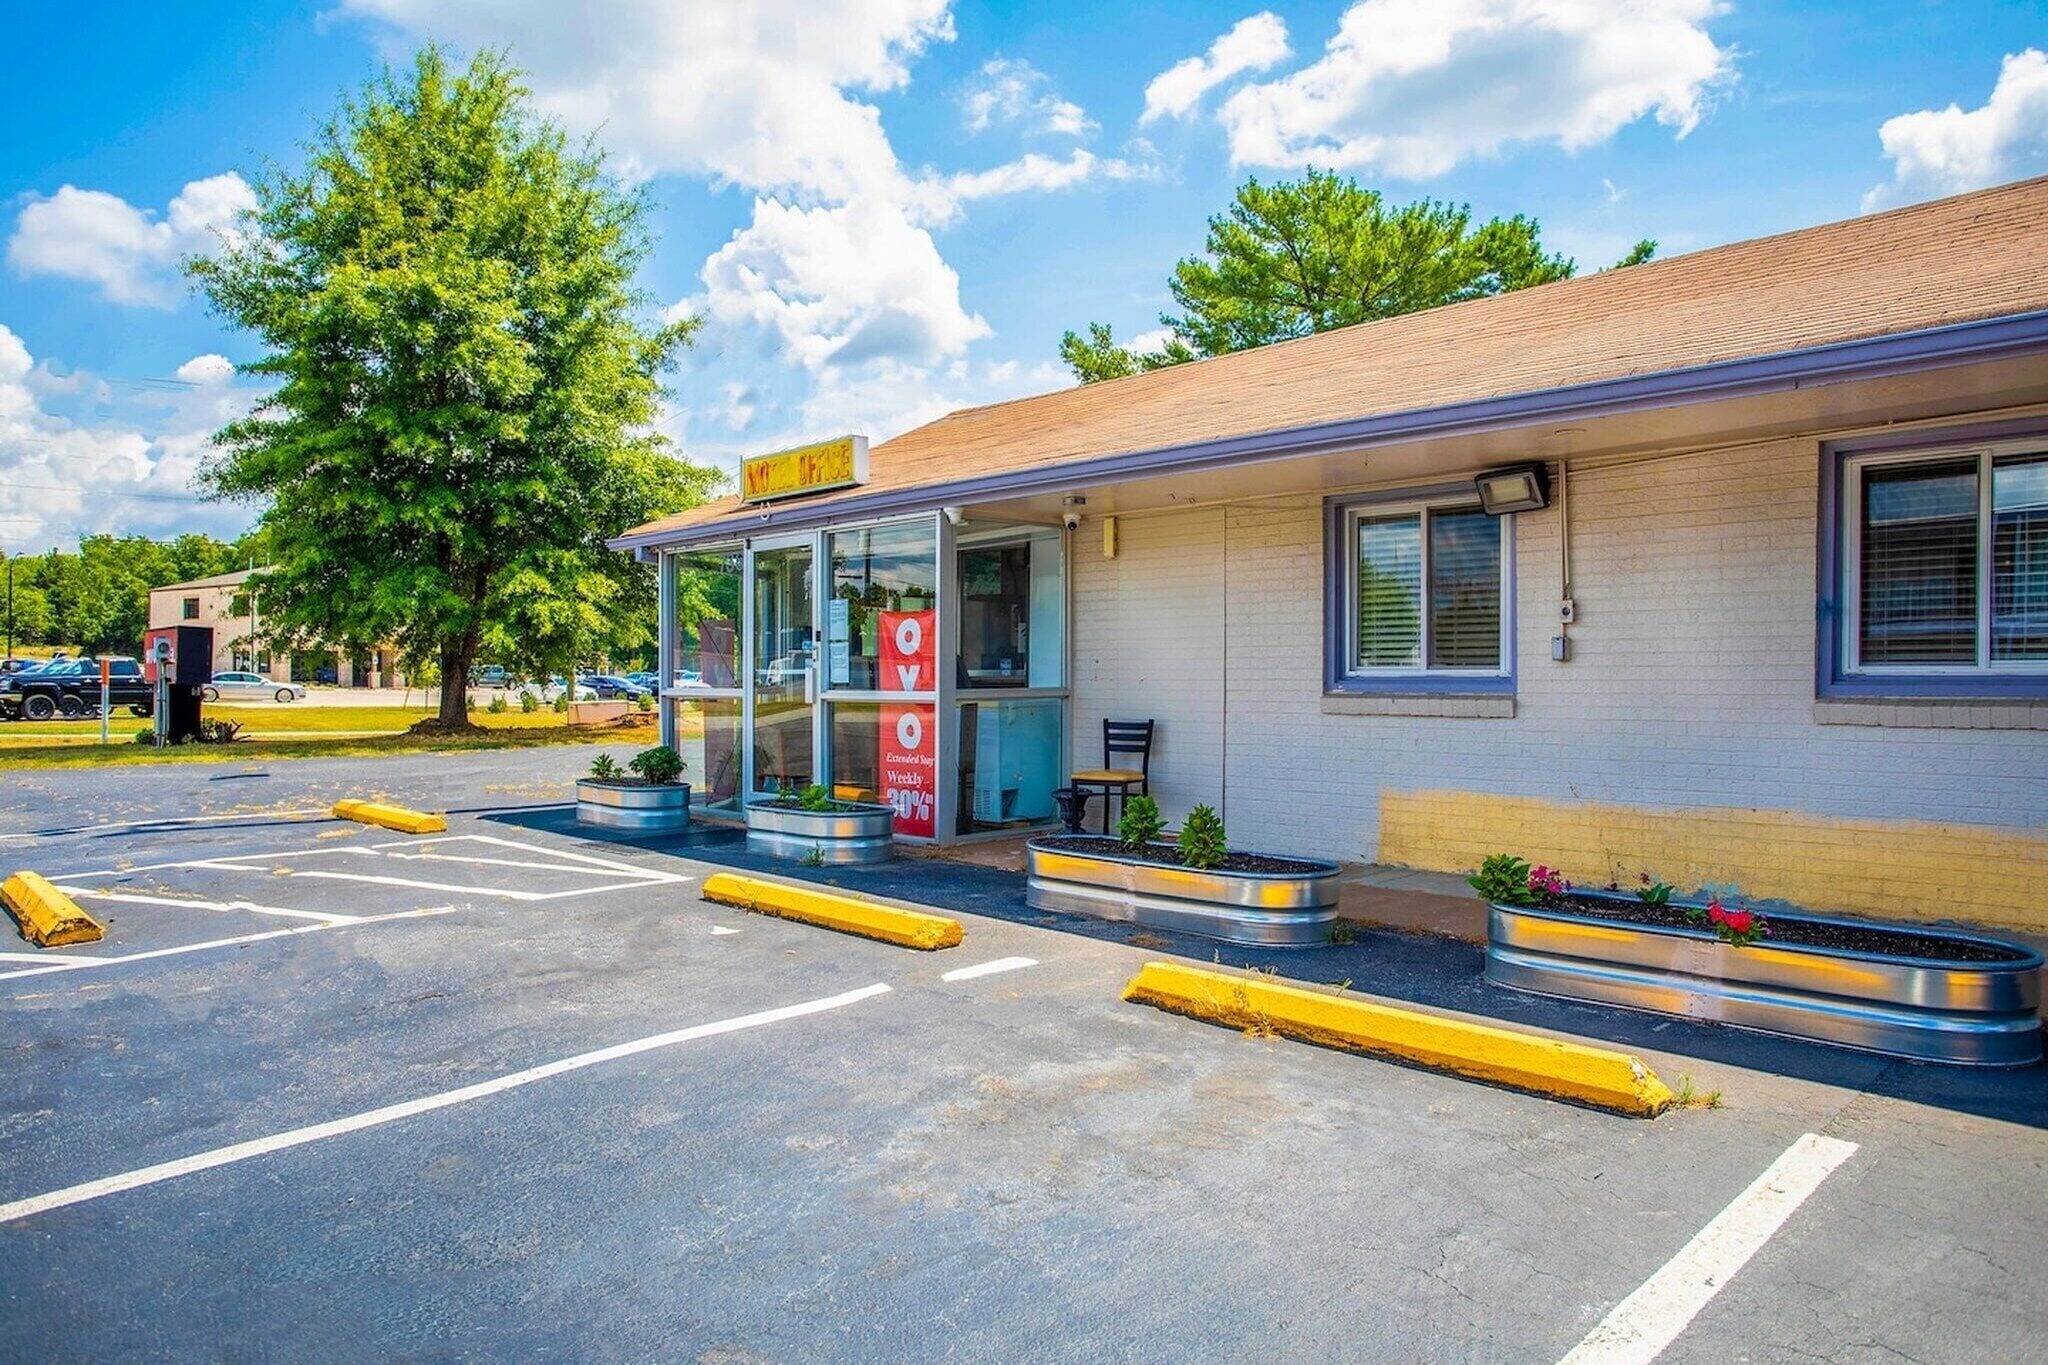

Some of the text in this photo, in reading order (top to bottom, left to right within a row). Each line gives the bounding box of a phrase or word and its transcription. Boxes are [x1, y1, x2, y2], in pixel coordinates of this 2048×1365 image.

[886, 752, 935, 767] Extended Stay
[886, 770, 924, 788] Weekly
[887, 787, 929, 820] 30%
